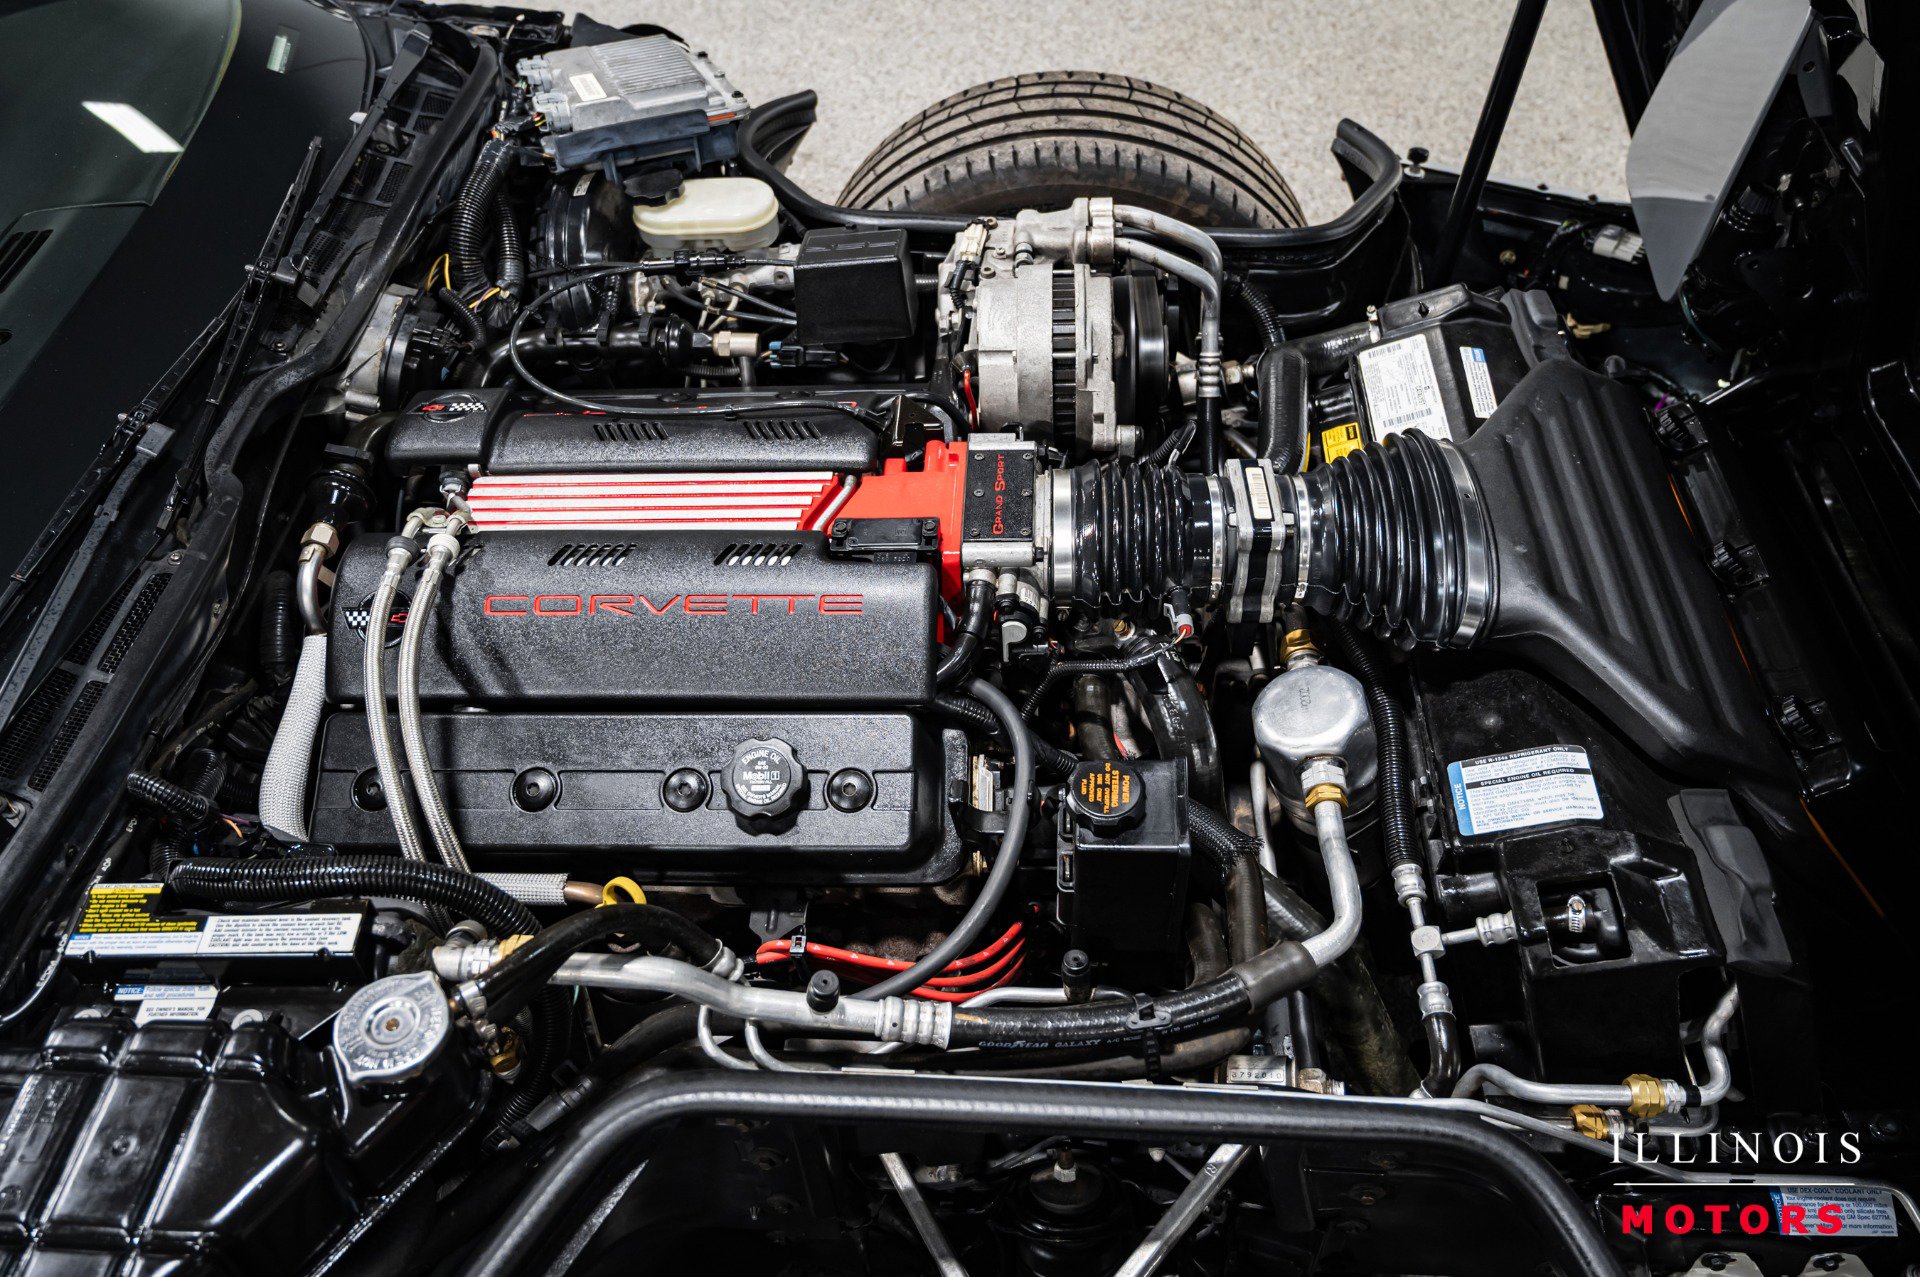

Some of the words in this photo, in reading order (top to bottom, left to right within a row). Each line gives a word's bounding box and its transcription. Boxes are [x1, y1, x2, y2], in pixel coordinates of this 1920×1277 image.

[994, 454, 1006, 491] SPORT
[992, 495, 1004, 535] GRAND
[484, 594, 863, 616] CORVETTE
[741, 750, 769, 764] ENGINE
[770, 752, 782, 764] OIL
[1509, 748, 1552, 759] REFRIGERANT
[743, 772, 770, 780] Mobil
[771, 771, 780, 780] 1
[1105, 762, 1111, 772] DO
[1507, 774, 1530, 782] ENGINE
[1111, 770, 1120, 808] STEERING
[1122, 775, 1130, 804] POWER
[1454, 783, 1466, 810] NOTICE
[978, 1040, 1049, 1049] GOODYEAR
[1054, 1038, 1101, 1048] GALAXY
